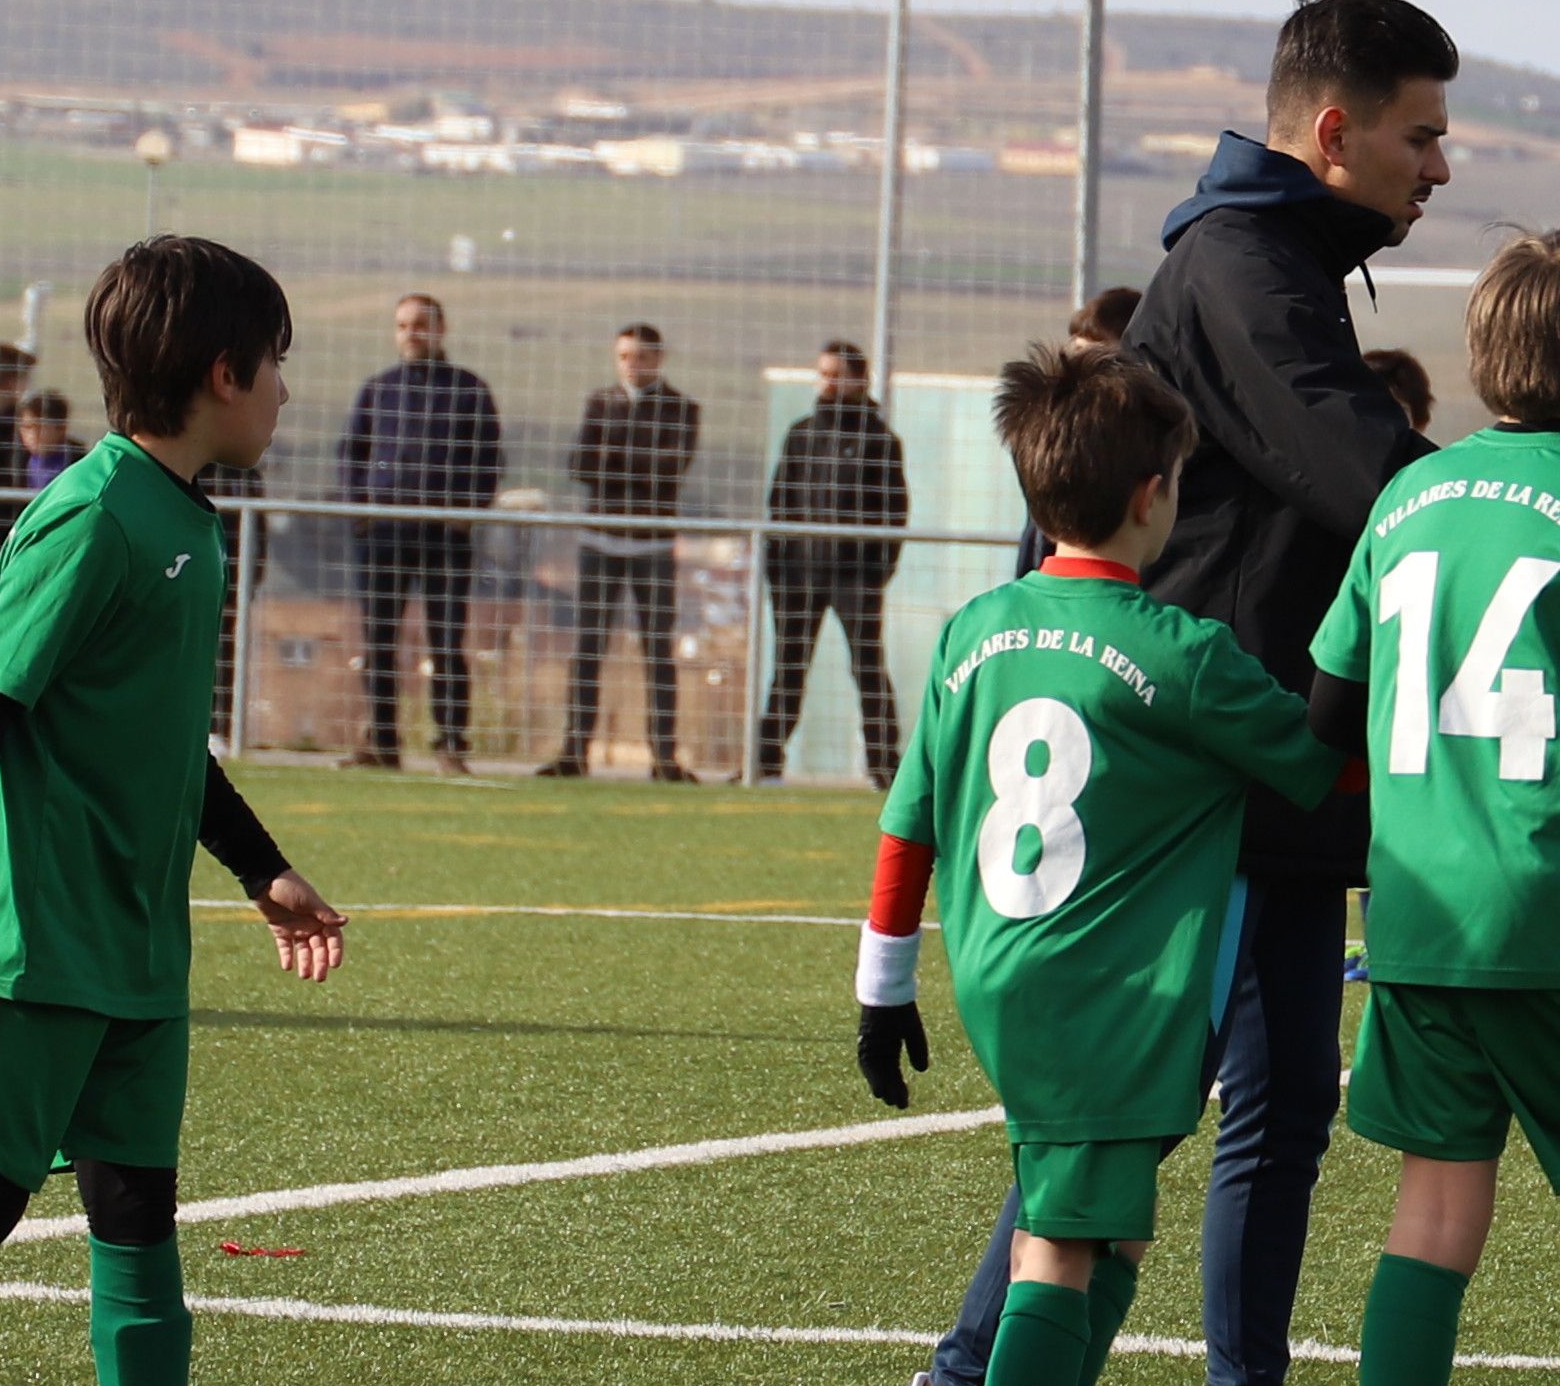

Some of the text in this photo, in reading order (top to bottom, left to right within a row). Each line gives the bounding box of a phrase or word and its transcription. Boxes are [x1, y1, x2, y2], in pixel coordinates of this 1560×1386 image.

[1375, 480, 1468, 538] VILLARES
[1471, 480, 1504, 499] DE
[1504, 483, 1533, 505] LA
[945, 629, 1157, 707] VILLARES DE LA REINA
[977, 697, 1093, 919] 8
